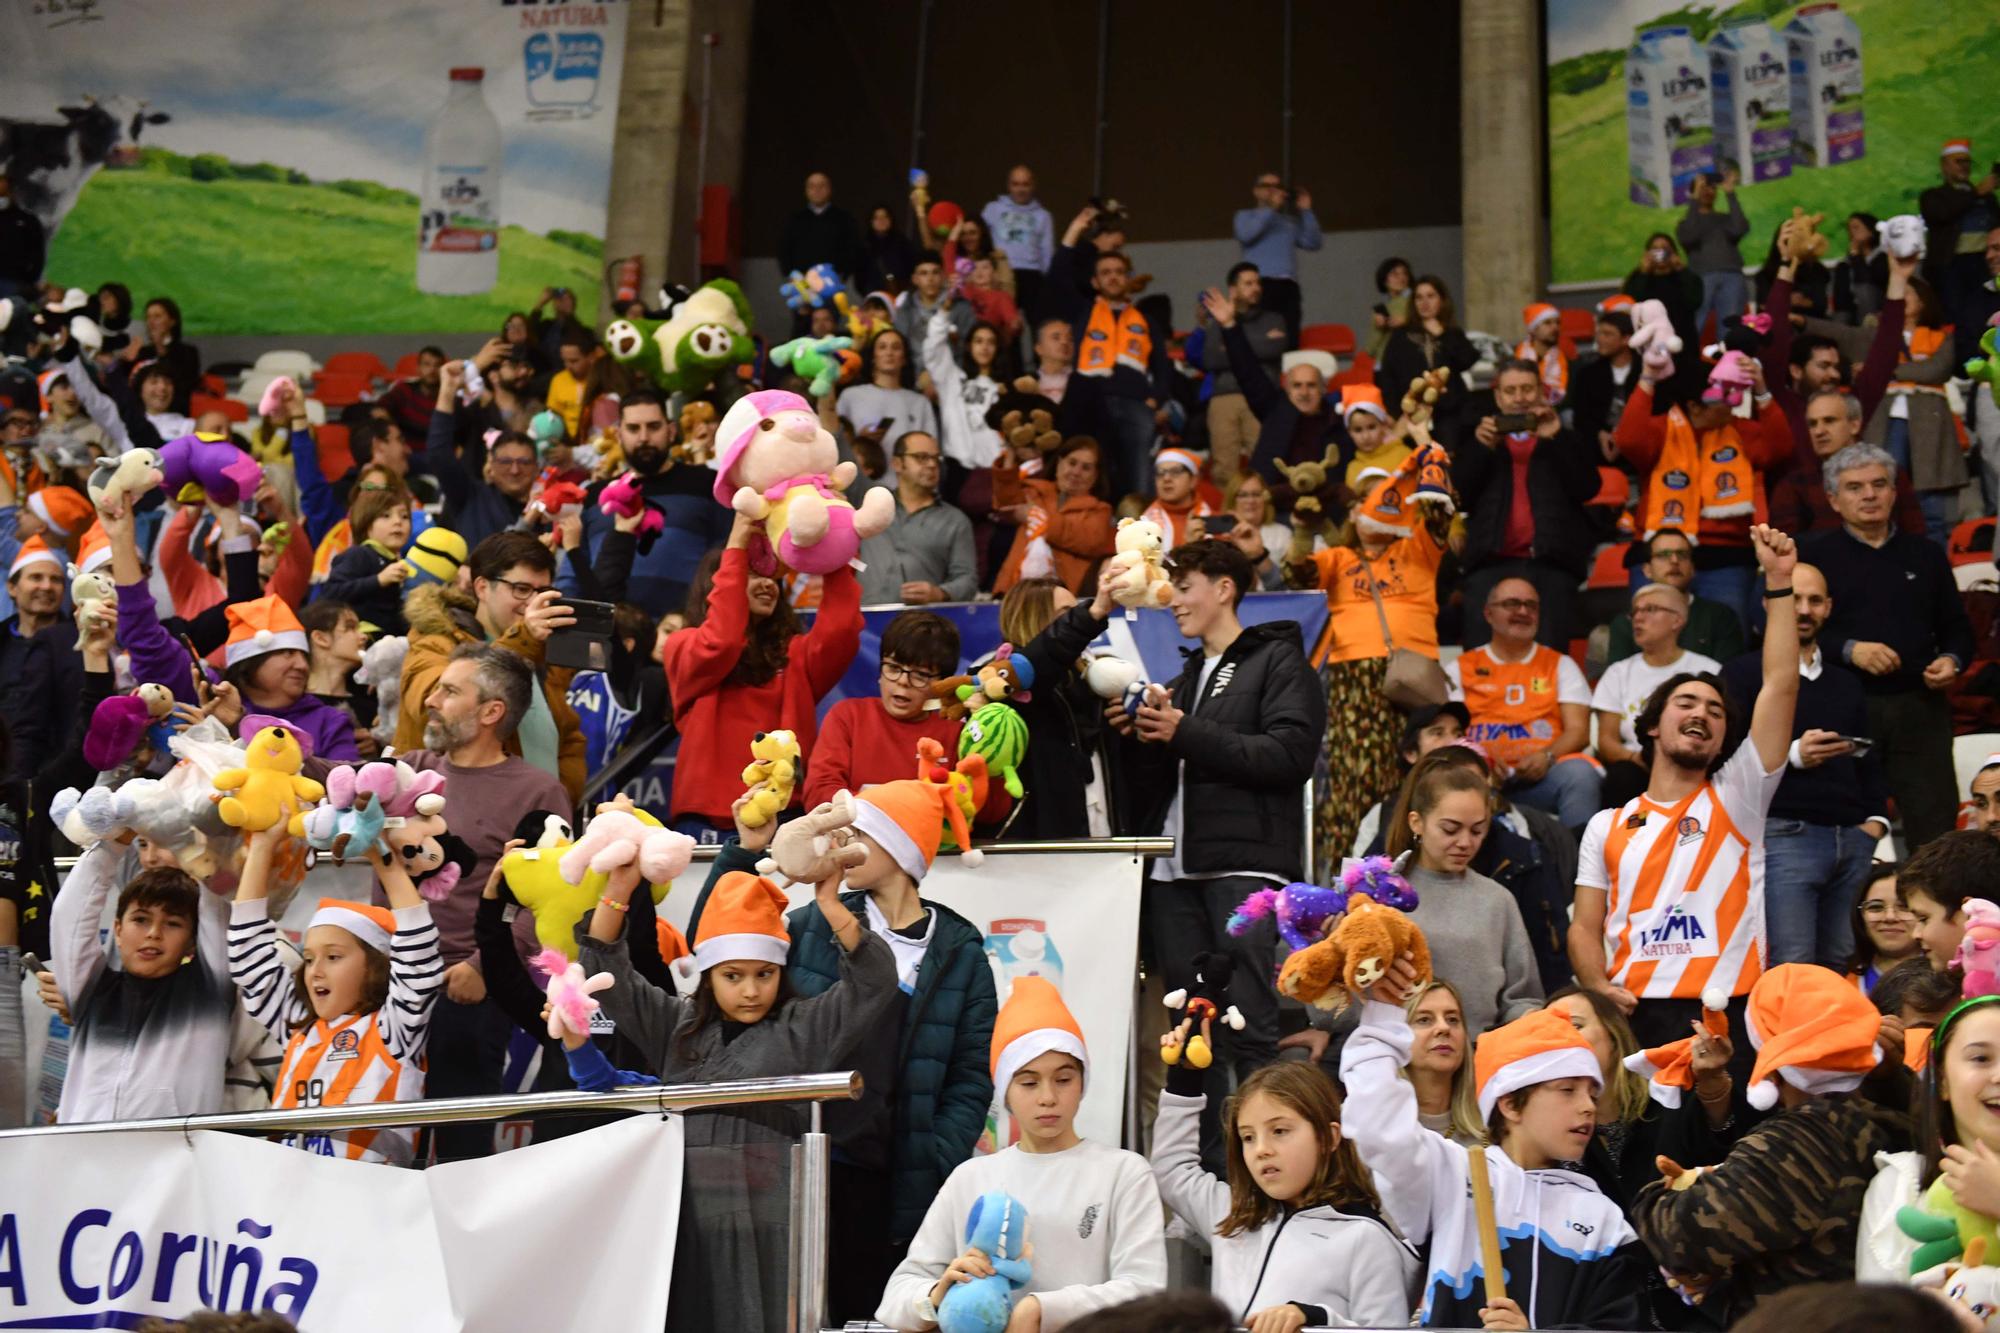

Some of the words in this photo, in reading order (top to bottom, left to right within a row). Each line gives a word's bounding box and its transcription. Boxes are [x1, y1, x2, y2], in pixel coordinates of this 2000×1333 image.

[521, 6, 607, 29] NATURA
[1640, 943, 1693, 957] NATURA
[295, 1078, 324, 1108] 99
[58, 1208, 319, 1327] Coruña
